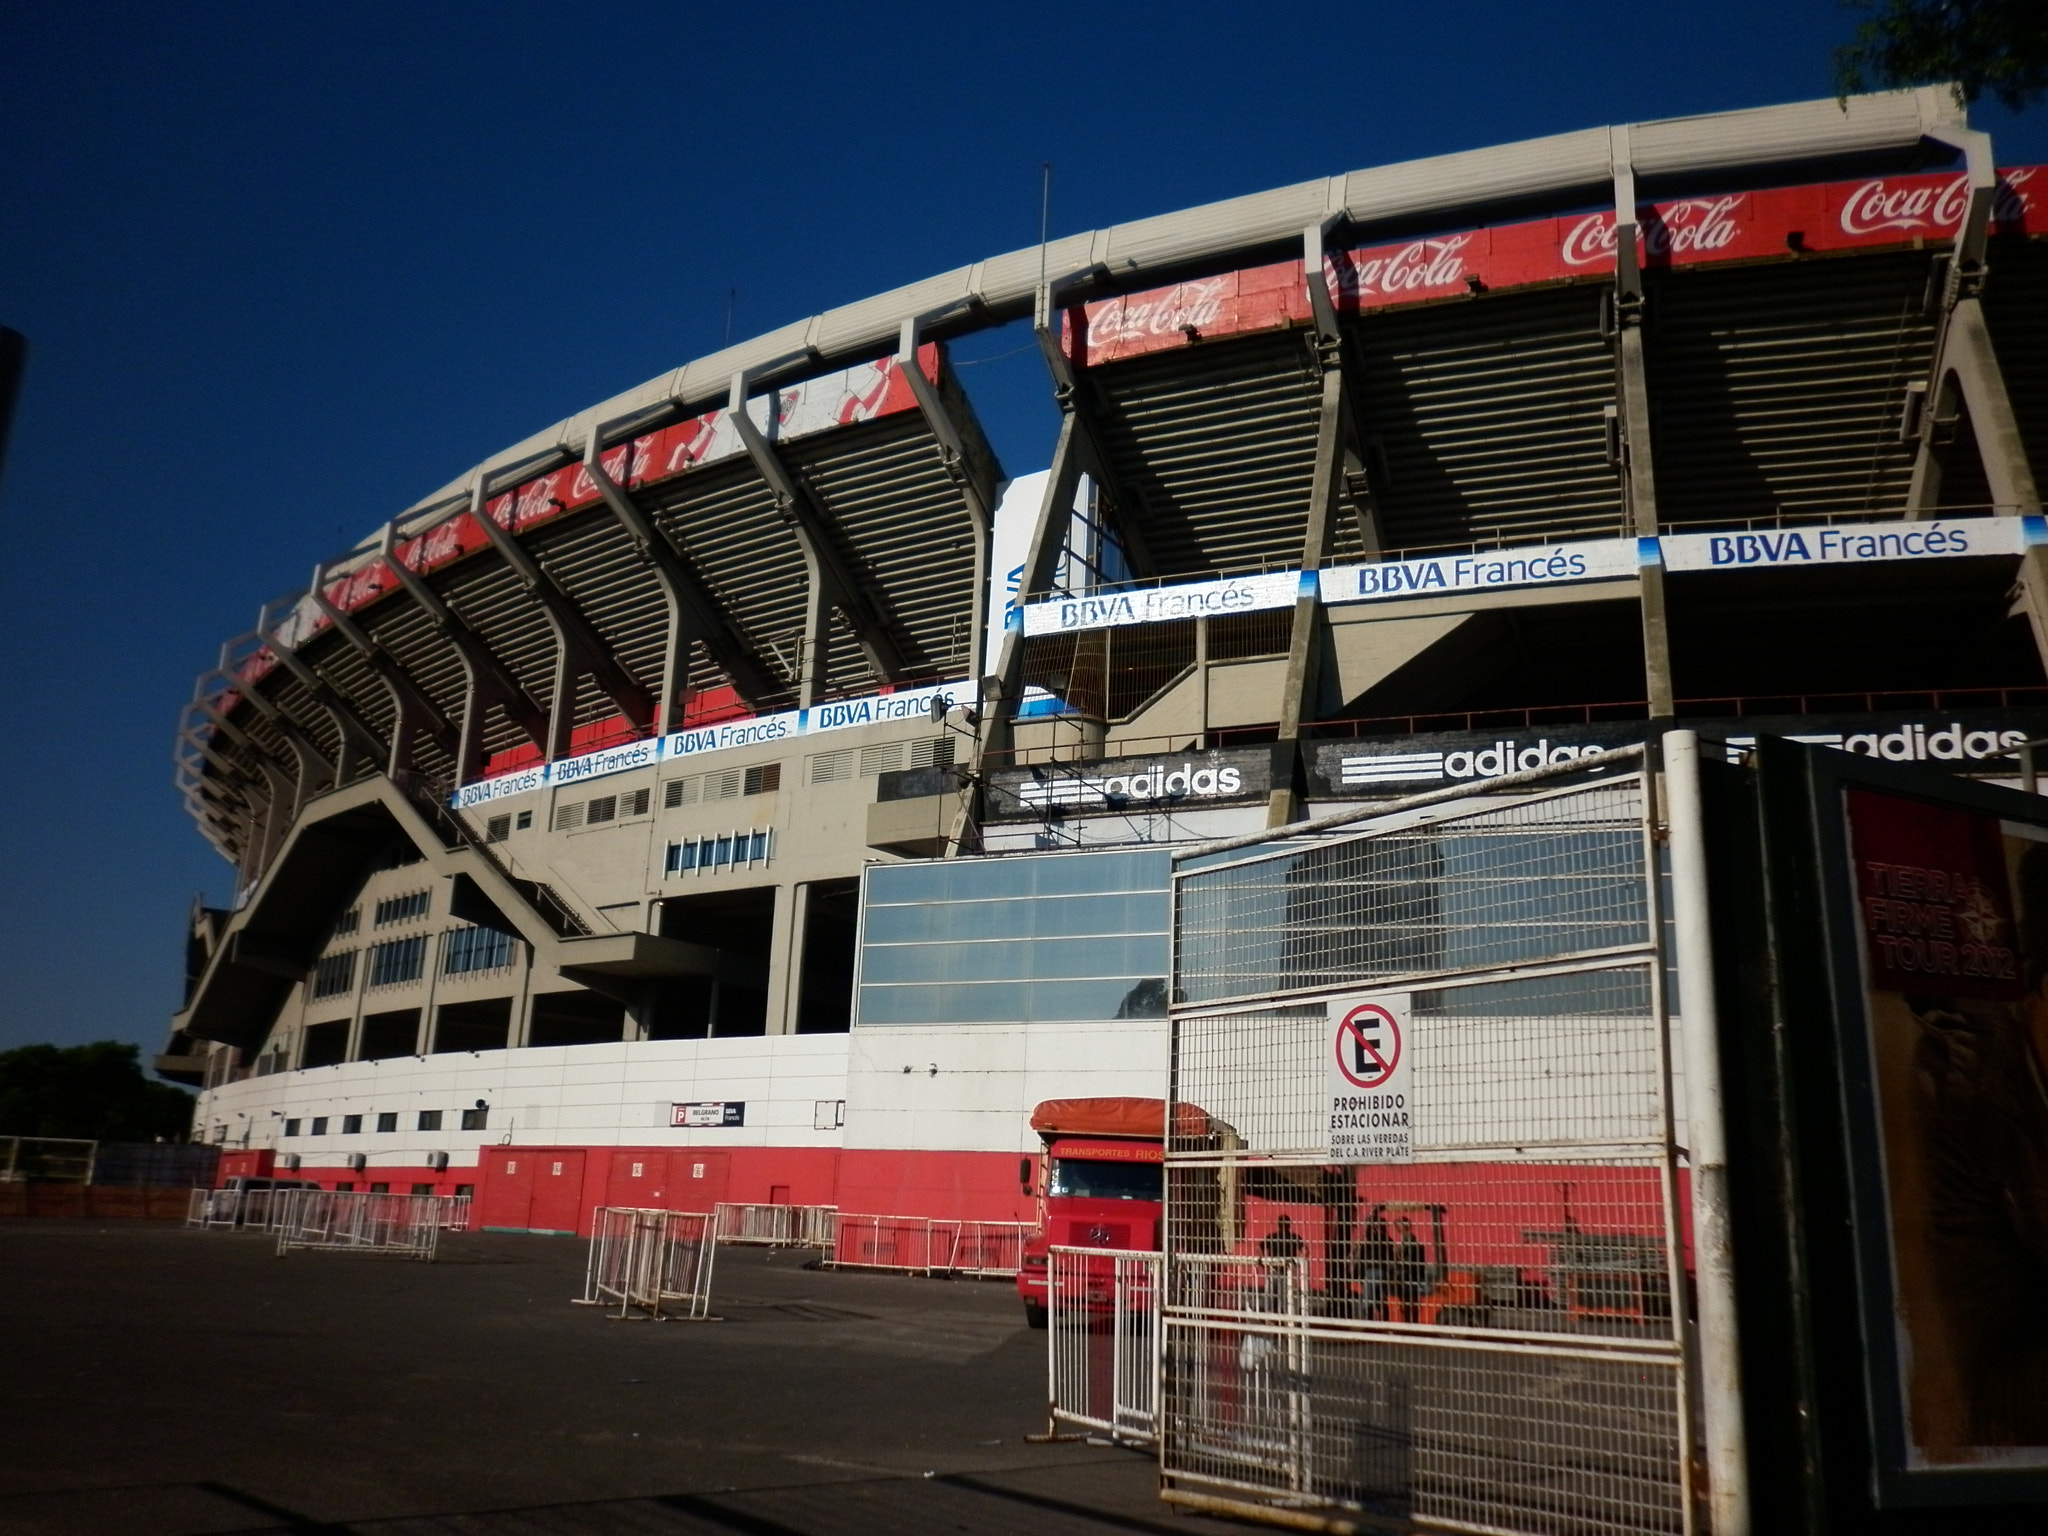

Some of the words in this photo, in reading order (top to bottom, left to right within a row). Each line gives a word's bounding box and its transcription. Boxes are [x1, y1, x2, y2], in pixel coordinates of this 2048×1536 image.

[1840, 166, 2036, 235] Coca-Cla
[1087, 275, 1232, 347] Coca-Cola
[1710, 532, 1811, 565] BBVA
[1819, 523, 1968, 560] Francés
[1358, 561, 1446, 595] BBVA
[1455, 548, 1586, 587] Francés
[1060, 596, 1135, 628] BBVA
[1146, 581, 1255, 618] Francés
[820, 701, 871, 728] BBVA
[674, 729, 716, 755] BBVA
[720, 717, 786, 747] Francés
[1845, 723, 2028, 761] adidas
[558, 757, 592, 781] BBVA
[594, 743, 648, 773] Francés
[1104, 763, 1241, 799] adidas
[463, 786, 491, 806] BBVA
[493, 769, 537, 798] Francés
[1867, 861, 1970, 903] TIERRA
[1866, 896, 1956, 939] FIRME
[1876, 934, 1960, 976] TOUR
[1961, 943, 2016, 980] 2012
[1331, 1112, 1409, 1129] ESTACIONAR
[1334, 1094, 1405, 1111] PROHIBIDO
[1060, 1147, 1130, 1158] TRANSPORTES
[1135, 1149, 1165, 1161] RIOS
[1330, 1148, 1343, 1158] DEL
[1386, 1146, 1409, 1157] PLATE
[1331, 1134, 1354, 1145] SOBRE
[1357, 1134, 1370, 1144] LAS
[1373, 1133, 1408, 1144] VEREDAS
